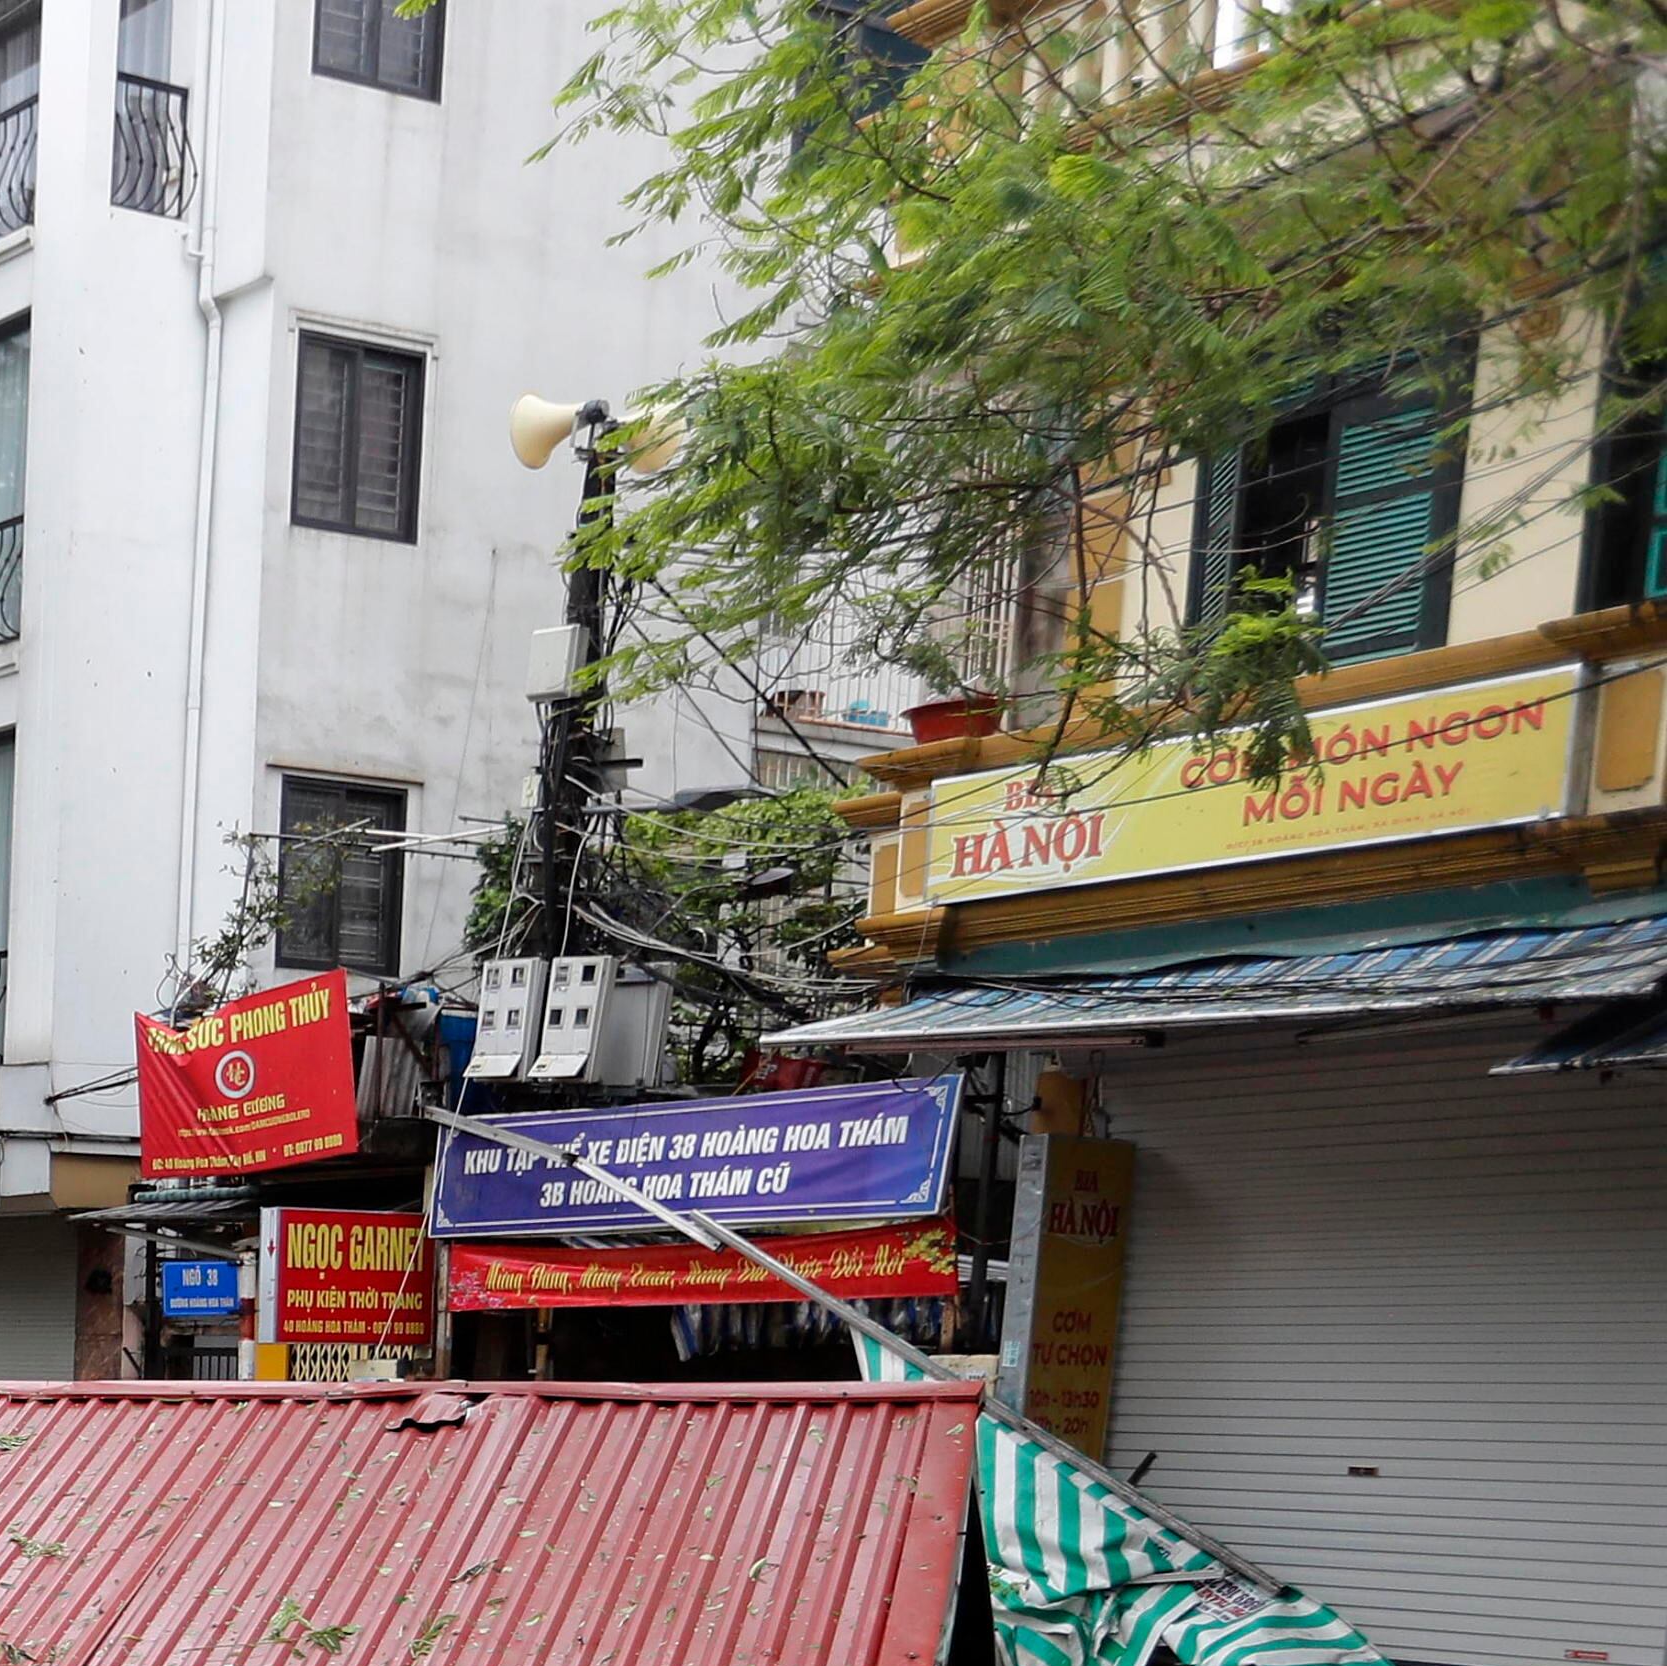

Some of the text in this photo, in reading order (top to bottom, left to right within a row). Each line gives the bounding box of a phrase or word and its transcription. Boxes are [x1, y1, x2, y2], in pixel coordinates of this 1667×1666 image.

[1405, 698, 1547, 753] NGON
[1243, 760, 1463, 826] MỖI NGÀY
[950, 808, 1106, 878] HÀ NỘI
[230, 1000, 287, 1043] PHONG
[288, 981, 332, 1028] THỦY
[464, 1149, 502, 1175] KHU
[587, 1139, 611, 1166] XE
[615, 1132, 666, 1169] ĐIỆN
[668, 1134, 697, 1161] 38
[699, 1124, 779, 1158] HOÀNG
[783, 1122, 831, 1152] HOA
[838, 1112, 909, 1148] THÁM
[539, 1182, 566, 1208] 3B
[642, 1173, 683, 1202] HOA
[689, 1164, 754, 1198] THÁM
[756, 1161, 791, 1195] CŨ
[1075, 1169, 1099, 1191] BIA
[1048, 1197, 1120, 1245] HÀ NỘI
[287, 1223, 426, 1280] NGỌC GARNET
[182, 1265, 201, 1287] NGÕ
[287, 1285, 423, 1313] PHỤ KIỆN THỜI TRANG
[295, 1317, 323, 1333] HOÀNG
[325, 1320, 341, 1333] HOA
[344, 1318, 365, 1333] THÁM
[1052, 1308, 1092, 1334] CƠM
[1032, 1341, 1054, 1371] TỰ
[1058, 1343, 1107, 1373] CHỌN
